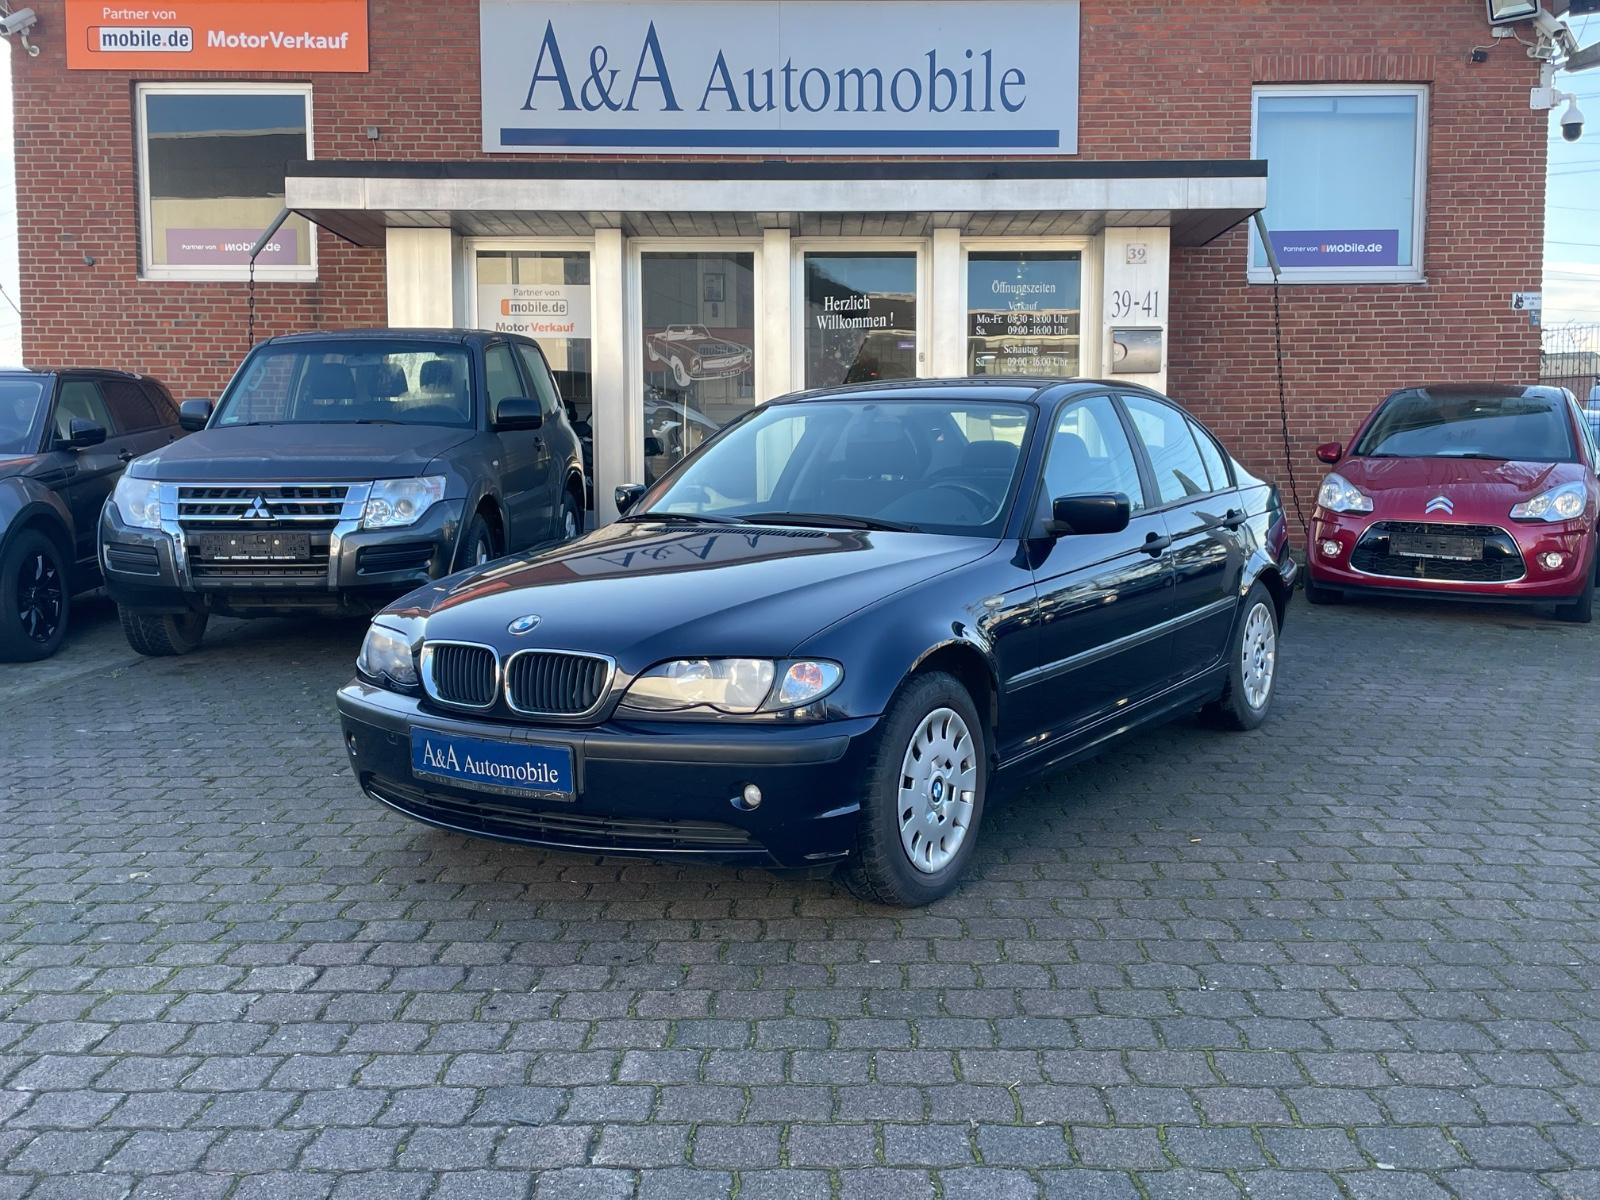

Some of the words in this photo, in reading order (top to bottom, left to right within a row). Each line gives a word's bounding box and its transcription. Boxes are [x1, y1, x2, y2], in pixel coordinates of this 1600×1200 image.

[102, 7, 150, 20] Partner
[152, 10, 177, 20] von
[102, 30, 189, 48] mobile.de
[520, 19, 684, 111] A&A
[697, 48, 1027, 112] Automobile
[225, 242, 281, 252] mobi.de
[1326, 243, 1383, 253] mobile.de
[1128, 248, 1146, 260] 39
[513, 288, 543, 297] Partner
[544, 289, 560, 297] von
[991, 280, 1056, 296] Öffnungszeiten
[511, 302, 566, 313] mobile.de
[824, 295, 870, 312] Herzlich
[1008, 301, 1038, 311] Verkauf
[1111, 289, 1159, 318] 39-41
[816, 314, 887, 330] Willkommen
[976, 314, 1004, 324] Mo.-Fr.
[1053, 314, 1069, 324] Uhr
[976, 325, 987, 336] Sa.
[1007, 325, 1028, 335] 09:00
[1053, 325, 1069, 335] Uhr
[1003, 344, 1039, 356] Schautag
[1007, 357, 1027, 367] 09:00
[1053, 357, 1067, 367] Uhr
[423, 739, 460, 772] A&A
[464, 755, 559, 783] Automobile
